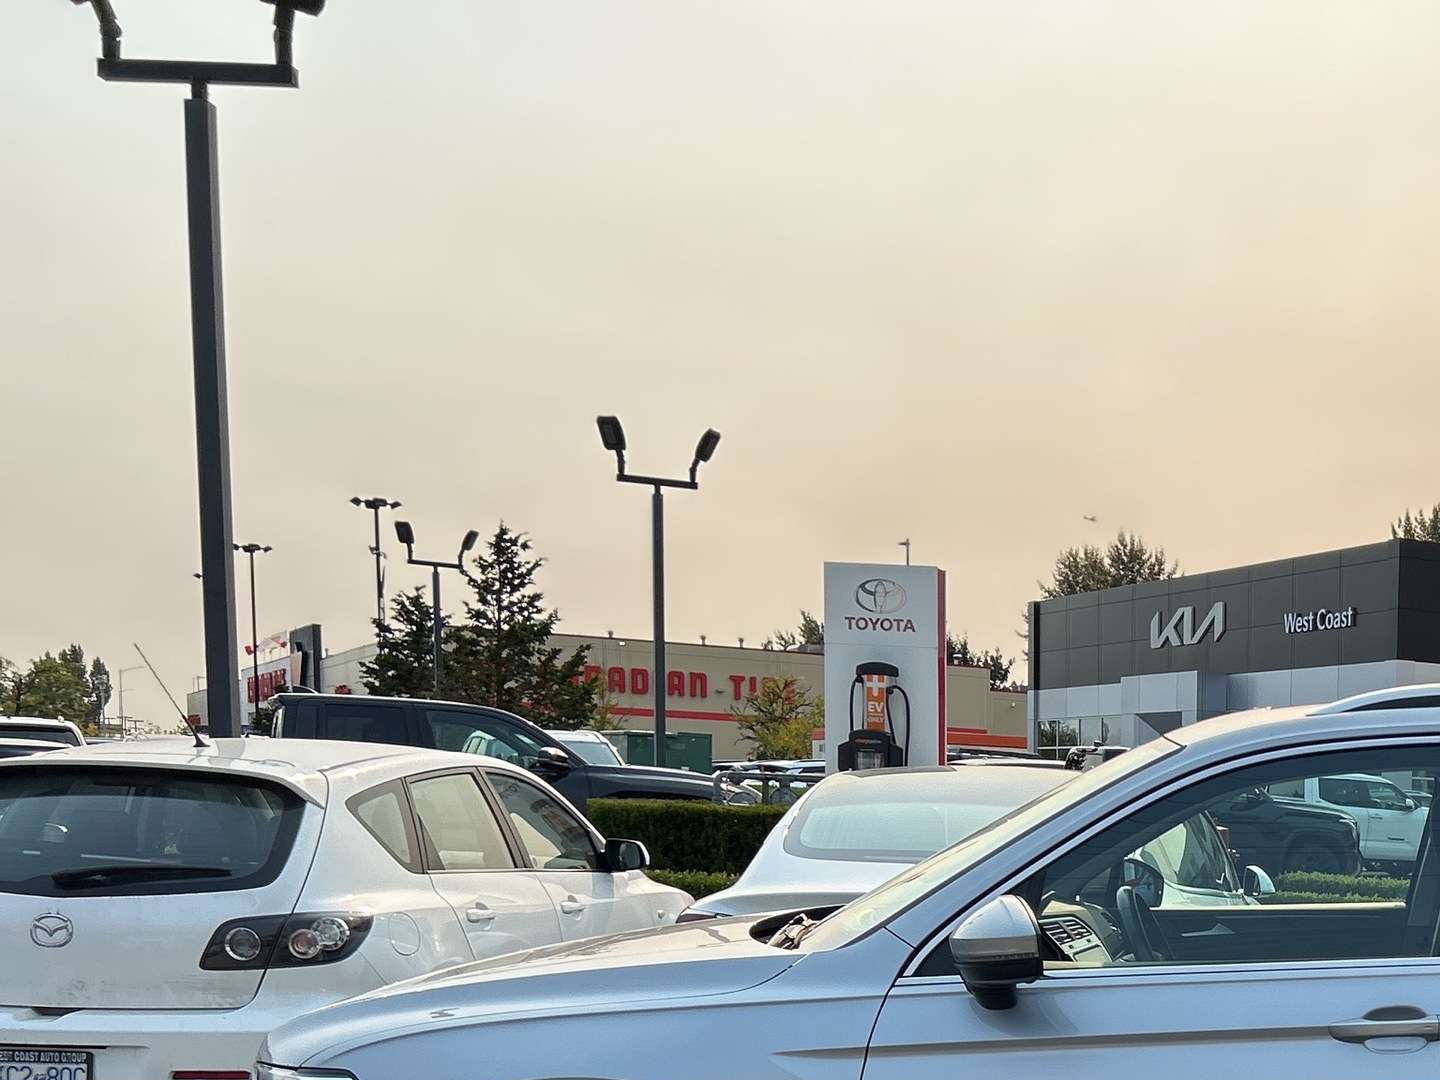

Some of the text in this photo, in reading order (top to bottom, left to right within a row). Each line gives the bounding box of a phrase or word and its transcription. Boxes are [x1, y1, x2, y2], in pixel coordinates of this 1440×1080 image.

[844, 616, 916, 633] TOYOTA
[1150, 601, 1227, 649] KIA
[1283, 606, 1353, 634] West Coast
[867, 701, 884, 713] EV
[14, 1051, 40, 1062] COAST
[40, 1053, 60, 1063] AUTO
